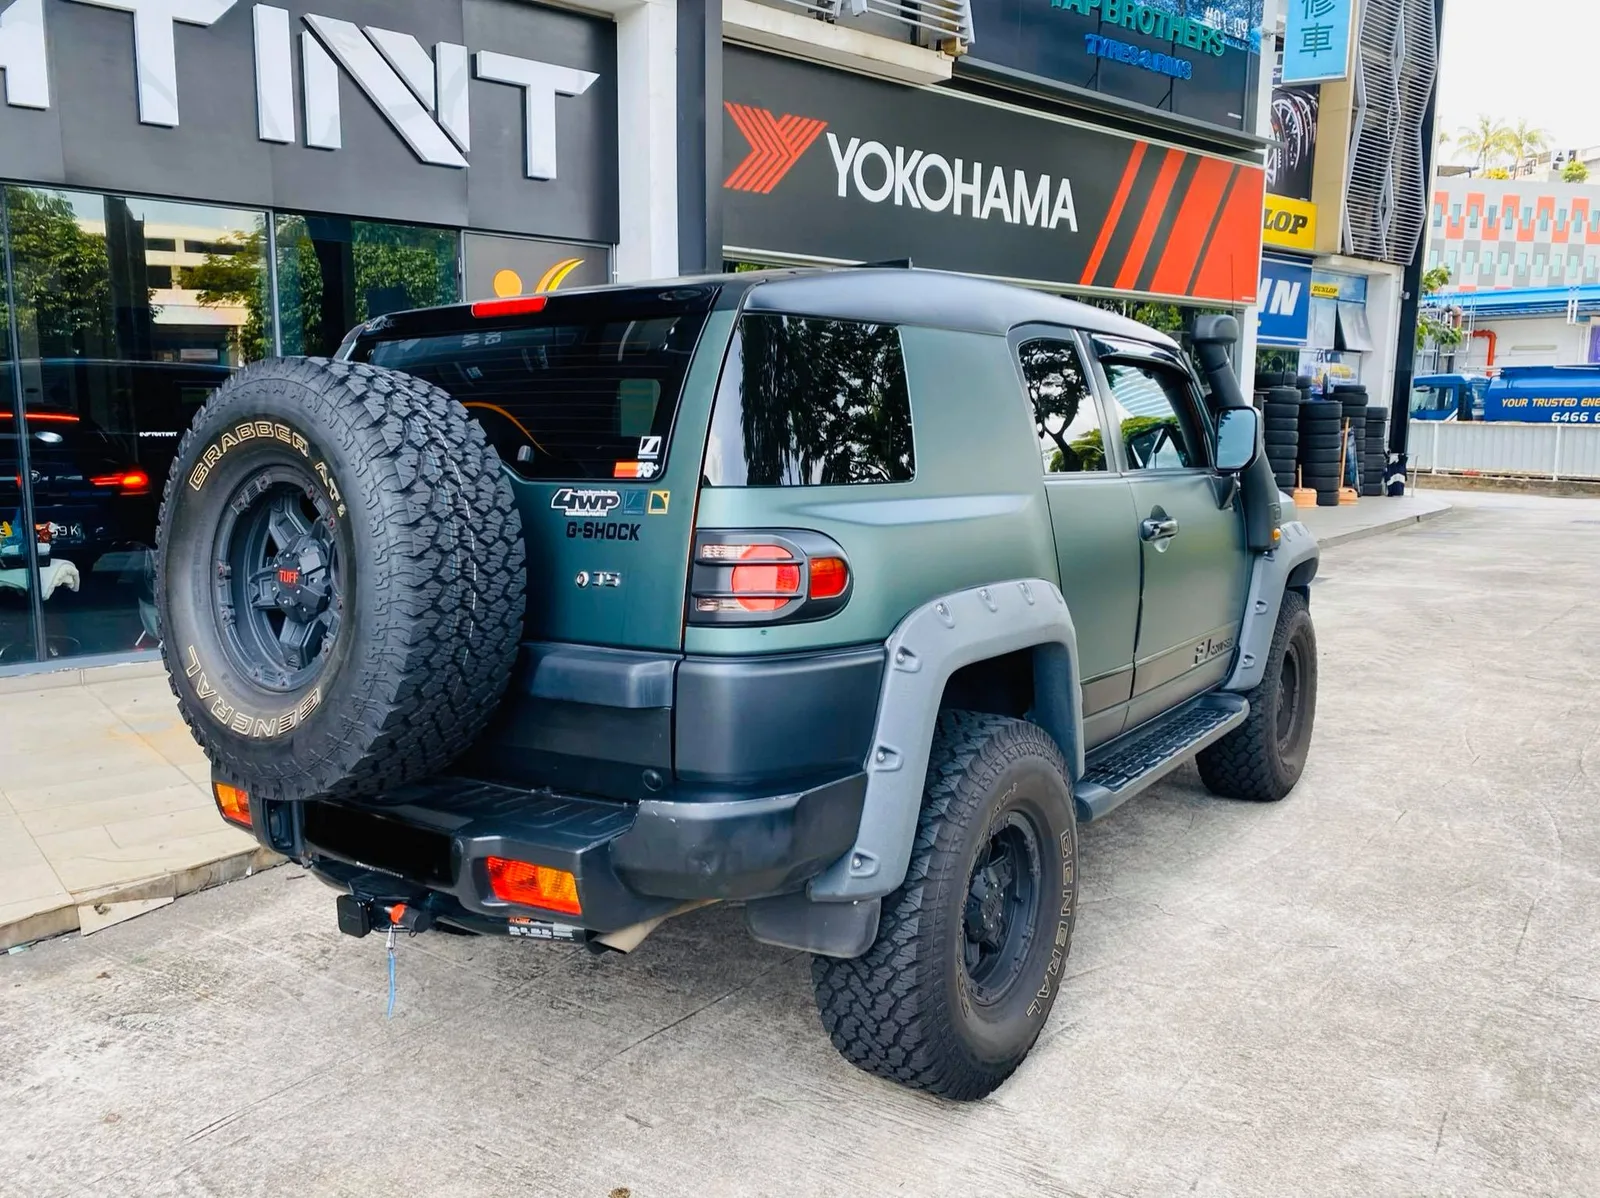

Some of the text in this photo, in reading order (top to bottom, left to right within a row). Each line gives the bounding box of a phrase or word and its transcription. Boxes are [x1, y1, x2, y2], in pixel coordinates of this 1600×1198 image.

[1100, 0, 1225, 57] BROTHERS
[826, 132, 1079, 233] YOKOHAMA
[1313, 285, 1338, 294] DUNLOP
[1502, 398, 1528, 407] YOUR
[1532, 397, 1577, 407] TRUSTED
[1551, 411, 1589, 422] 6466
[189, 420, 309, 492] GRABBER
[551, 488, 621, 512] 4WP
[566, 521, 641, 541] G-SHOCK
[279, 570, 299, 584] TUFF
[186, 645, 321, 738] GENERAL
[1027, 829, 1073, 1017] GENERAL
